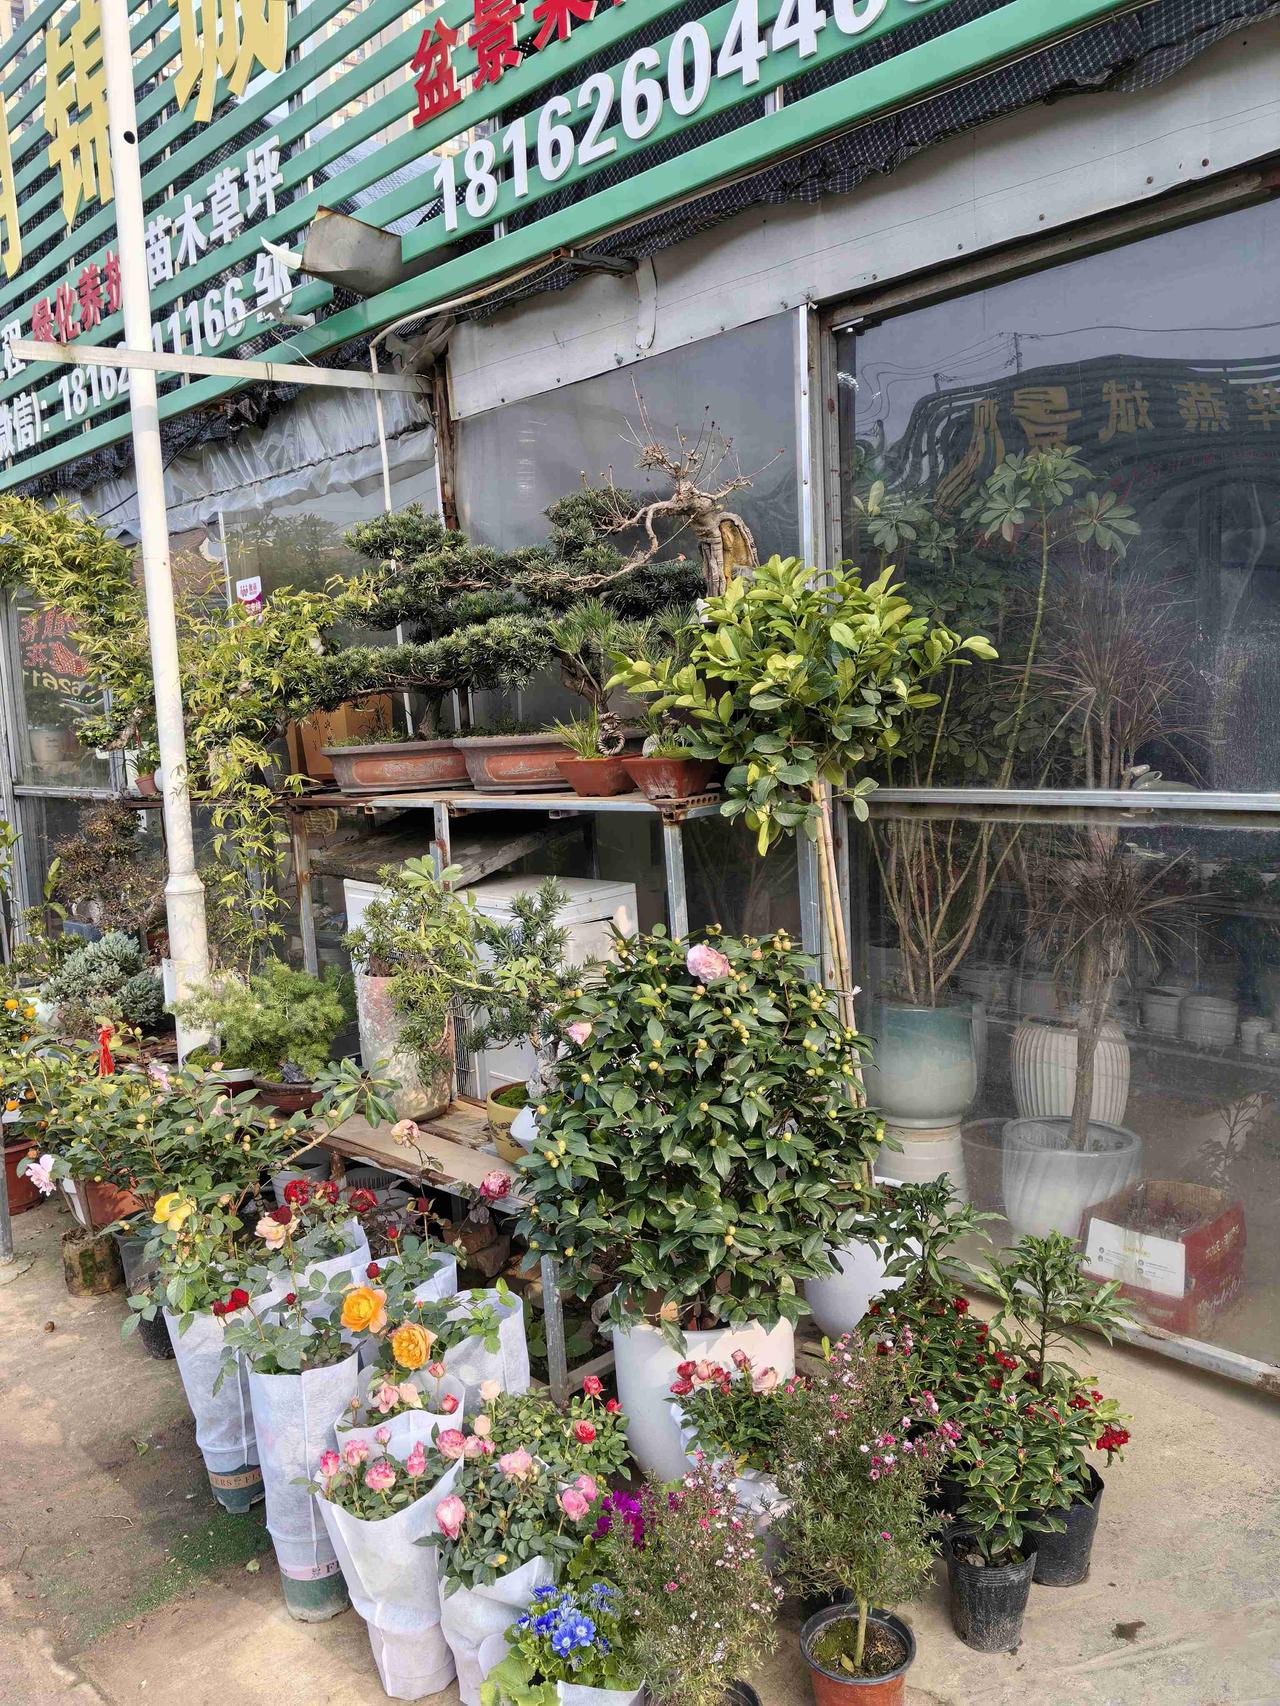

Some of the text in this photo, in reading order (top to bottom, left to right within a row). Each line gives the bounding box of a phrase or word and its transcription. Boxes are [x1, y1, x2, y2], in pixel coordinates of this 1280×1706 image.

[144, 135, 284, 290] 苗木草坪
[433, 0, 930, 232] 181626044
